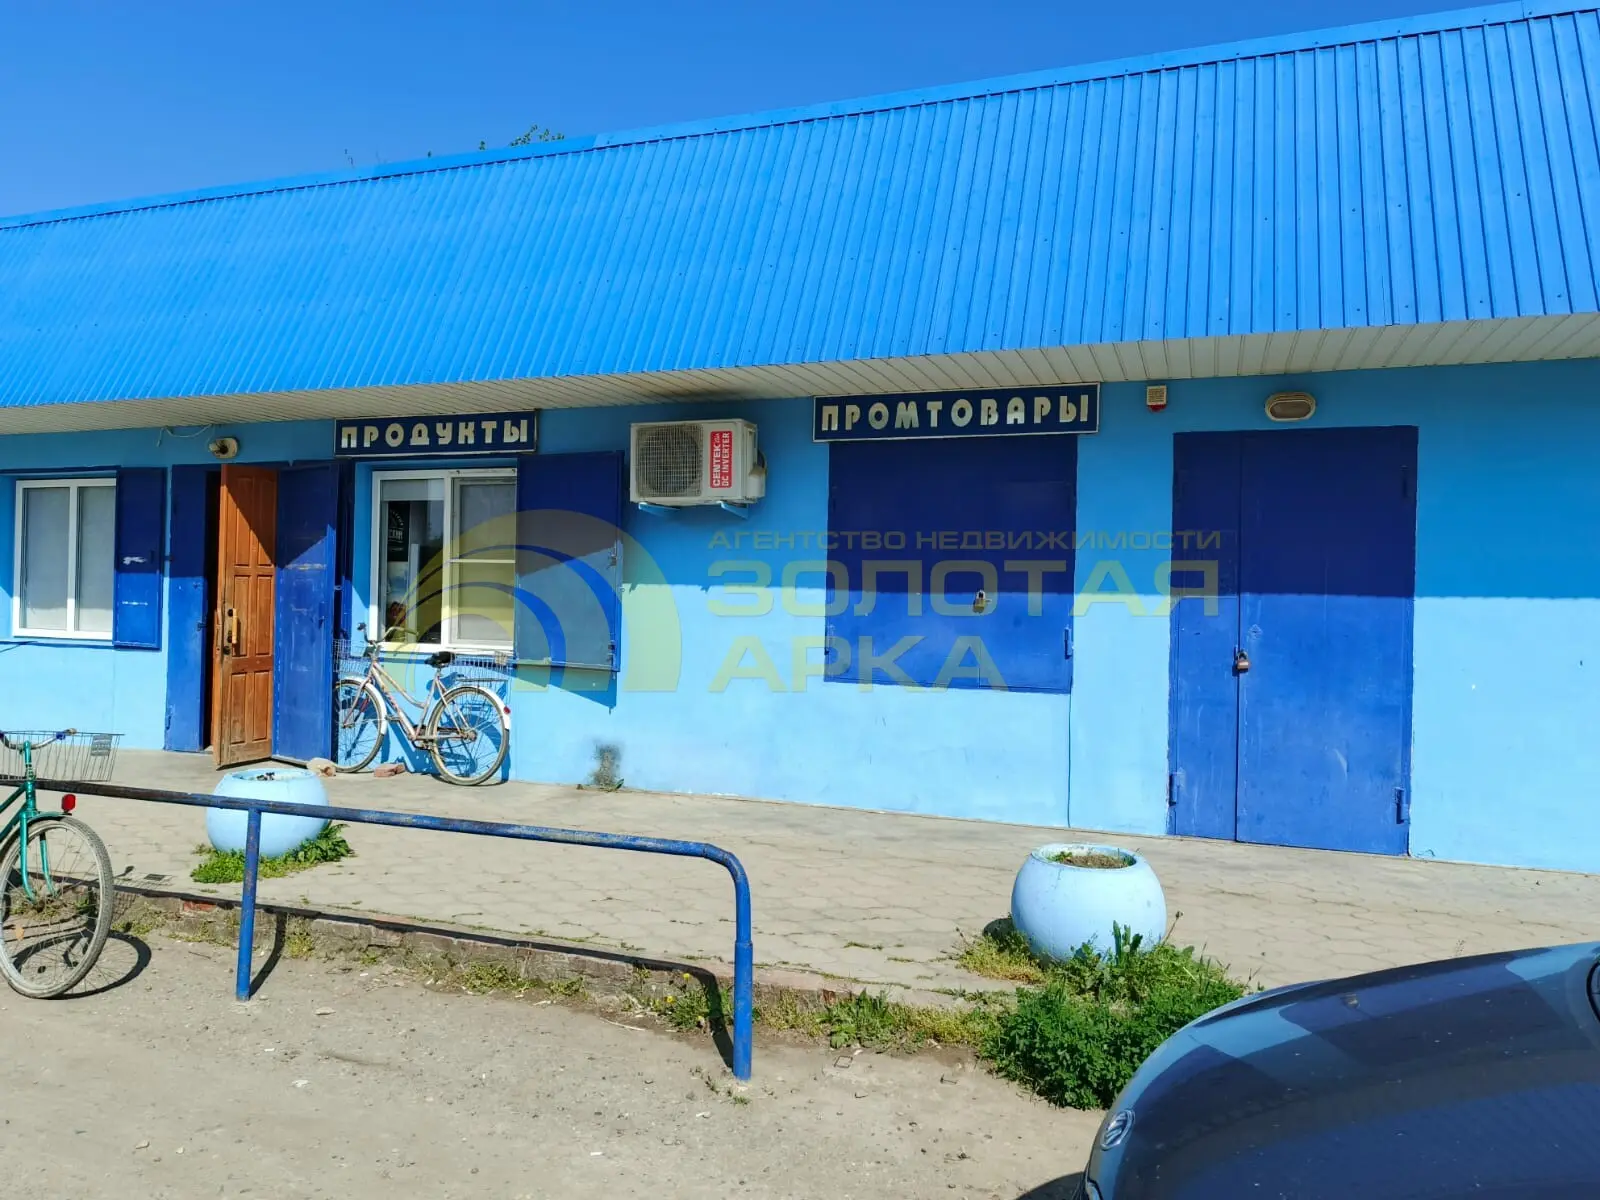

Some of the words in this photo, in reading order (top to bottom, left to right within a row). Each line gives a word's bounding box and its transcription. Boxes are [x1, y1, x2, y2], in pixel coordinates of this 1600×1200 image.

[821, 394, 1089, 431] ПРОМТОВАРЫ
[341, 419, 528, 448] ПРОДУКТЫ
[712, 443, 721, 487] CENTEK
[721, 432, 730, 473] INVERTER
[721, 475, 729, 487] DC
